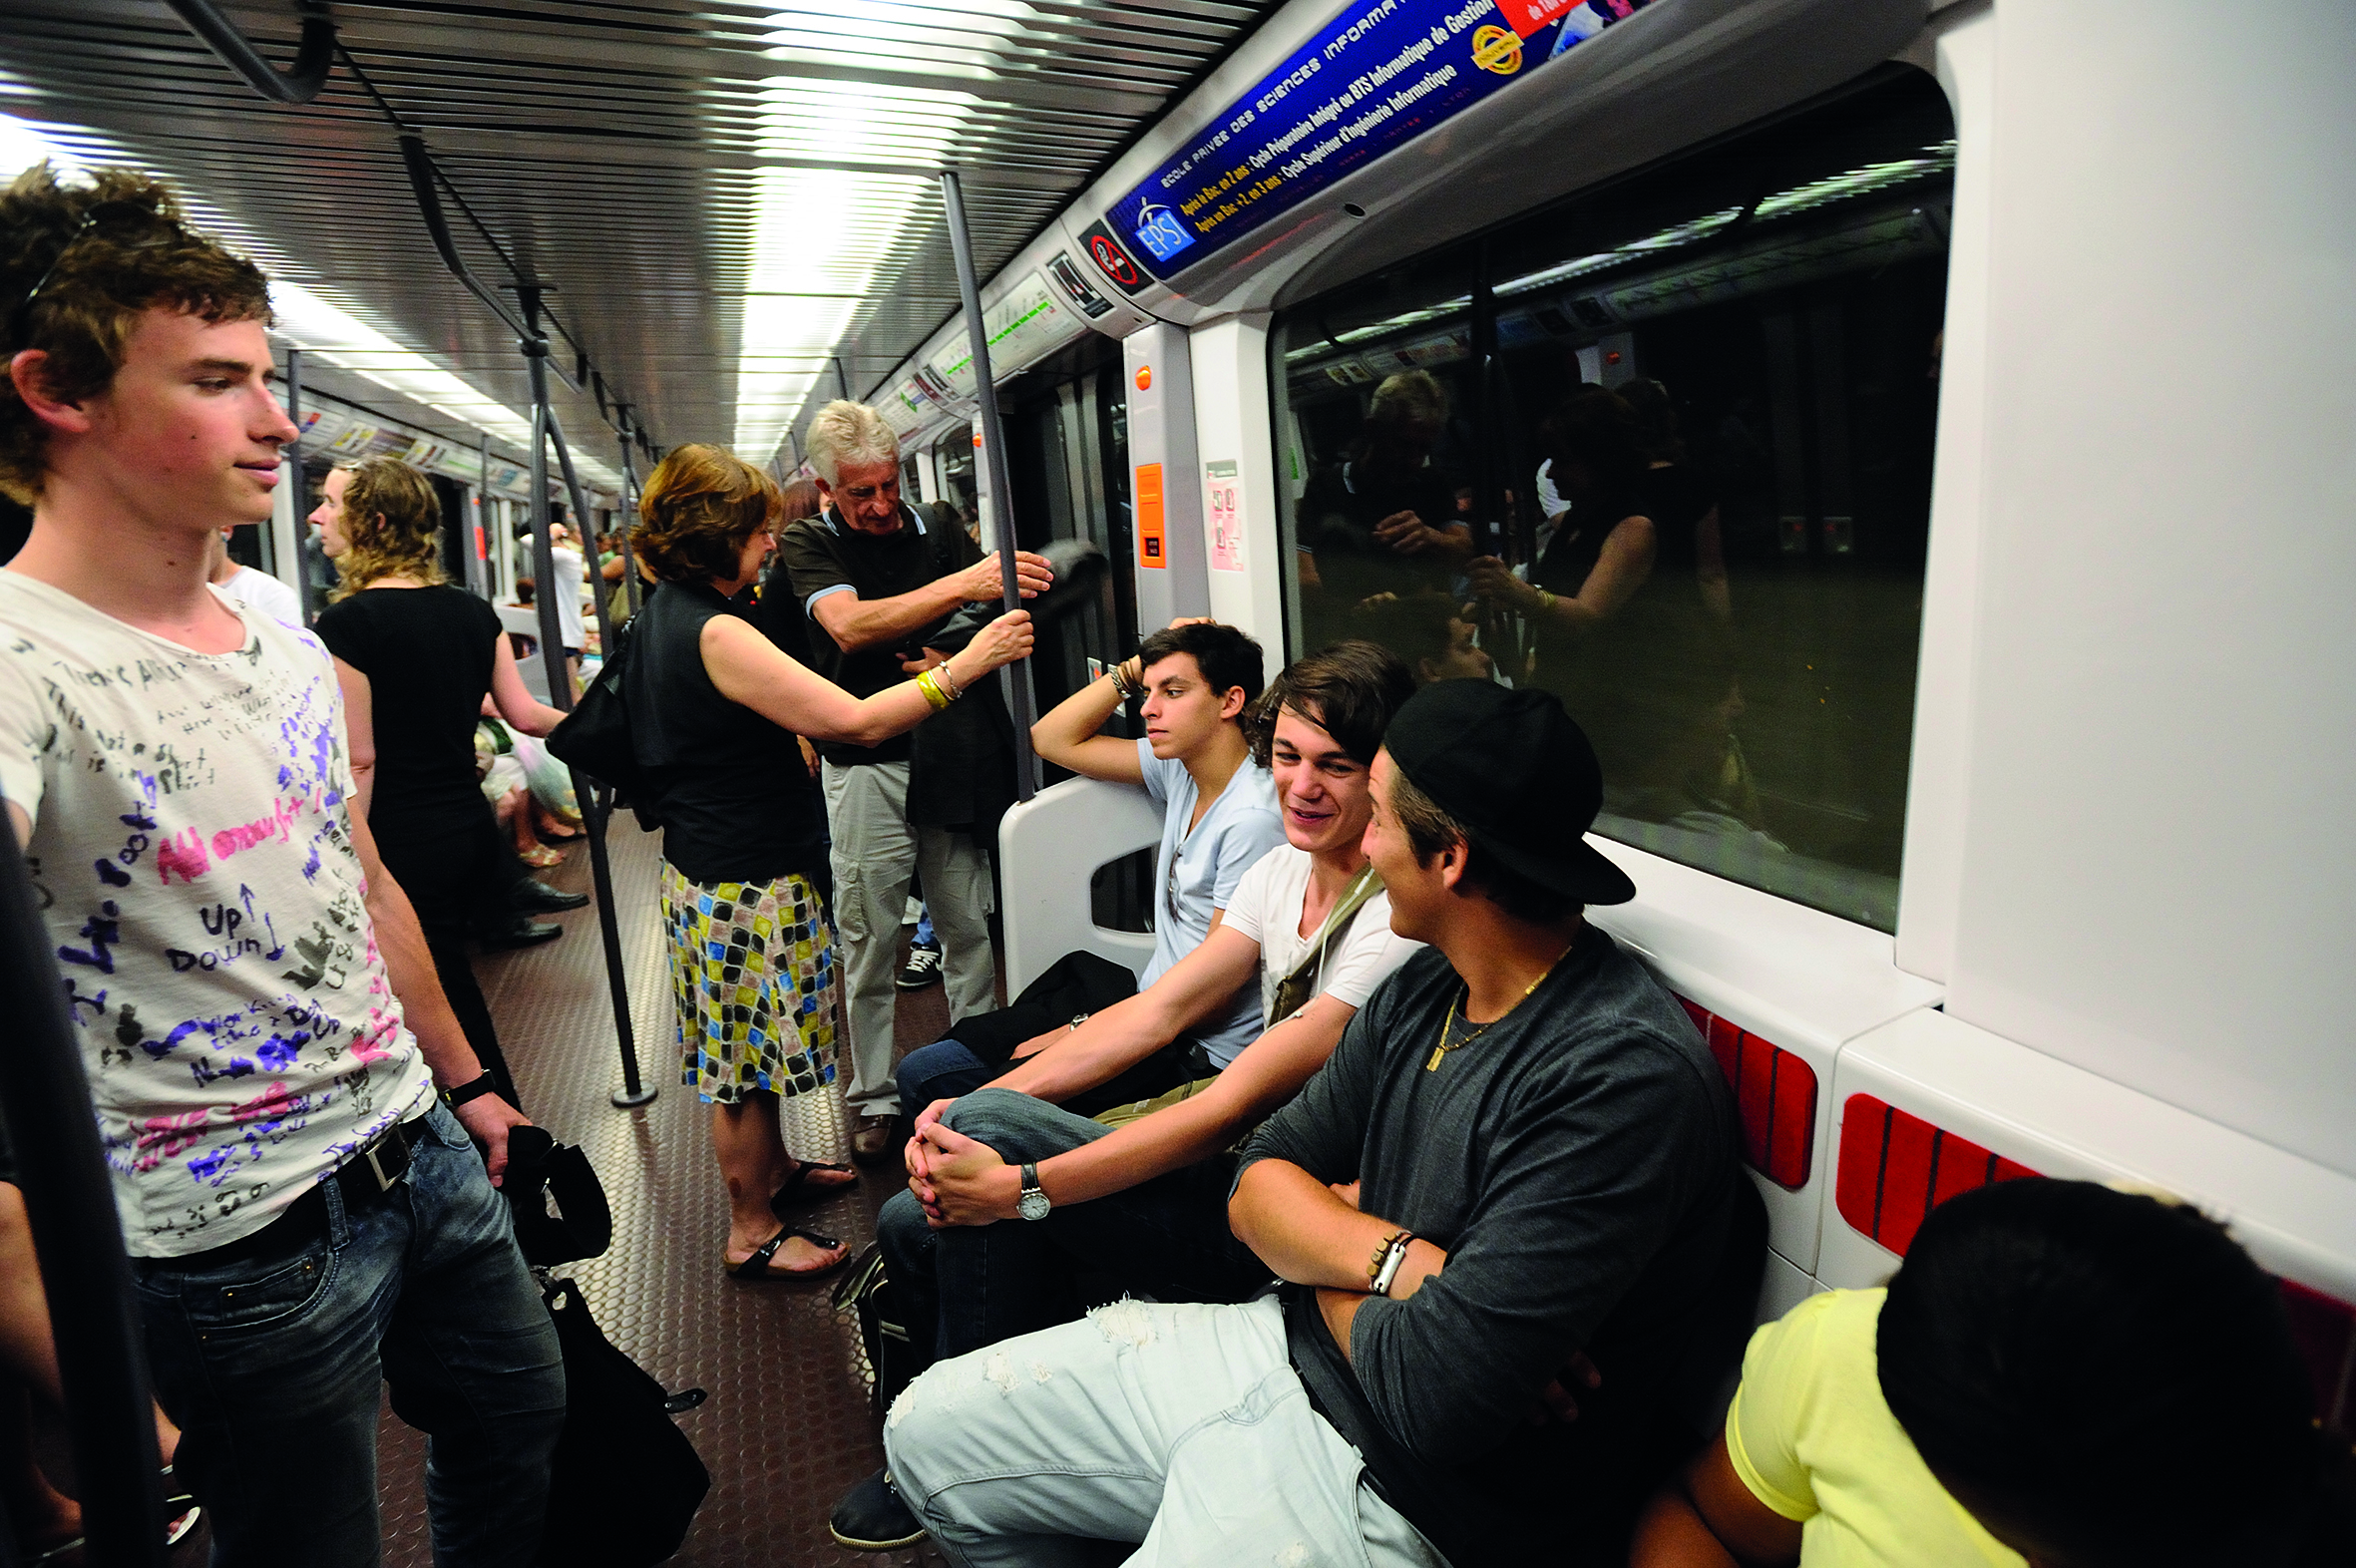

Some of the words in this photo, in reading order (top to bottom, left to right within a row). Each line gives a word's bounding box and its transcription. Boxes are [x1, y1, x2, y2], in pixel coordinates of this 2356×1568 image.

[1160, 160, 1193, 189] ECOLE
[1192, 130, 1230, 164] PRIVEE
[1229, 109, 1256, 134] DES
[1255, 57, 1322, 114] SCIENCES
[1323, 0, 1405, 61] INFORMA
[1225, 171, 1238, 185] 2
[1248, 149, 1273, 169] Cycle
[1266, 120, 1316, 157] Préparatoire
[1308, 97, 1344, 128] Intégré
[1339, 92, 1356, 108] ou
[1348, 75, 1374, 101] BTS
[1367, 37, 1435, 88] Informatique
[1429, 26, 1450, 46] de
[1443, 0, 1496, 34] Gestion
[1255, 182, 1268, 195] 3
[1280, 159, 1308, 179] Cycle
[1300, 135, 1345, 166] Supérieur
[1385, 64, 1458, 112] Informatique
[1138, 212, 1190, 258] EPSI
